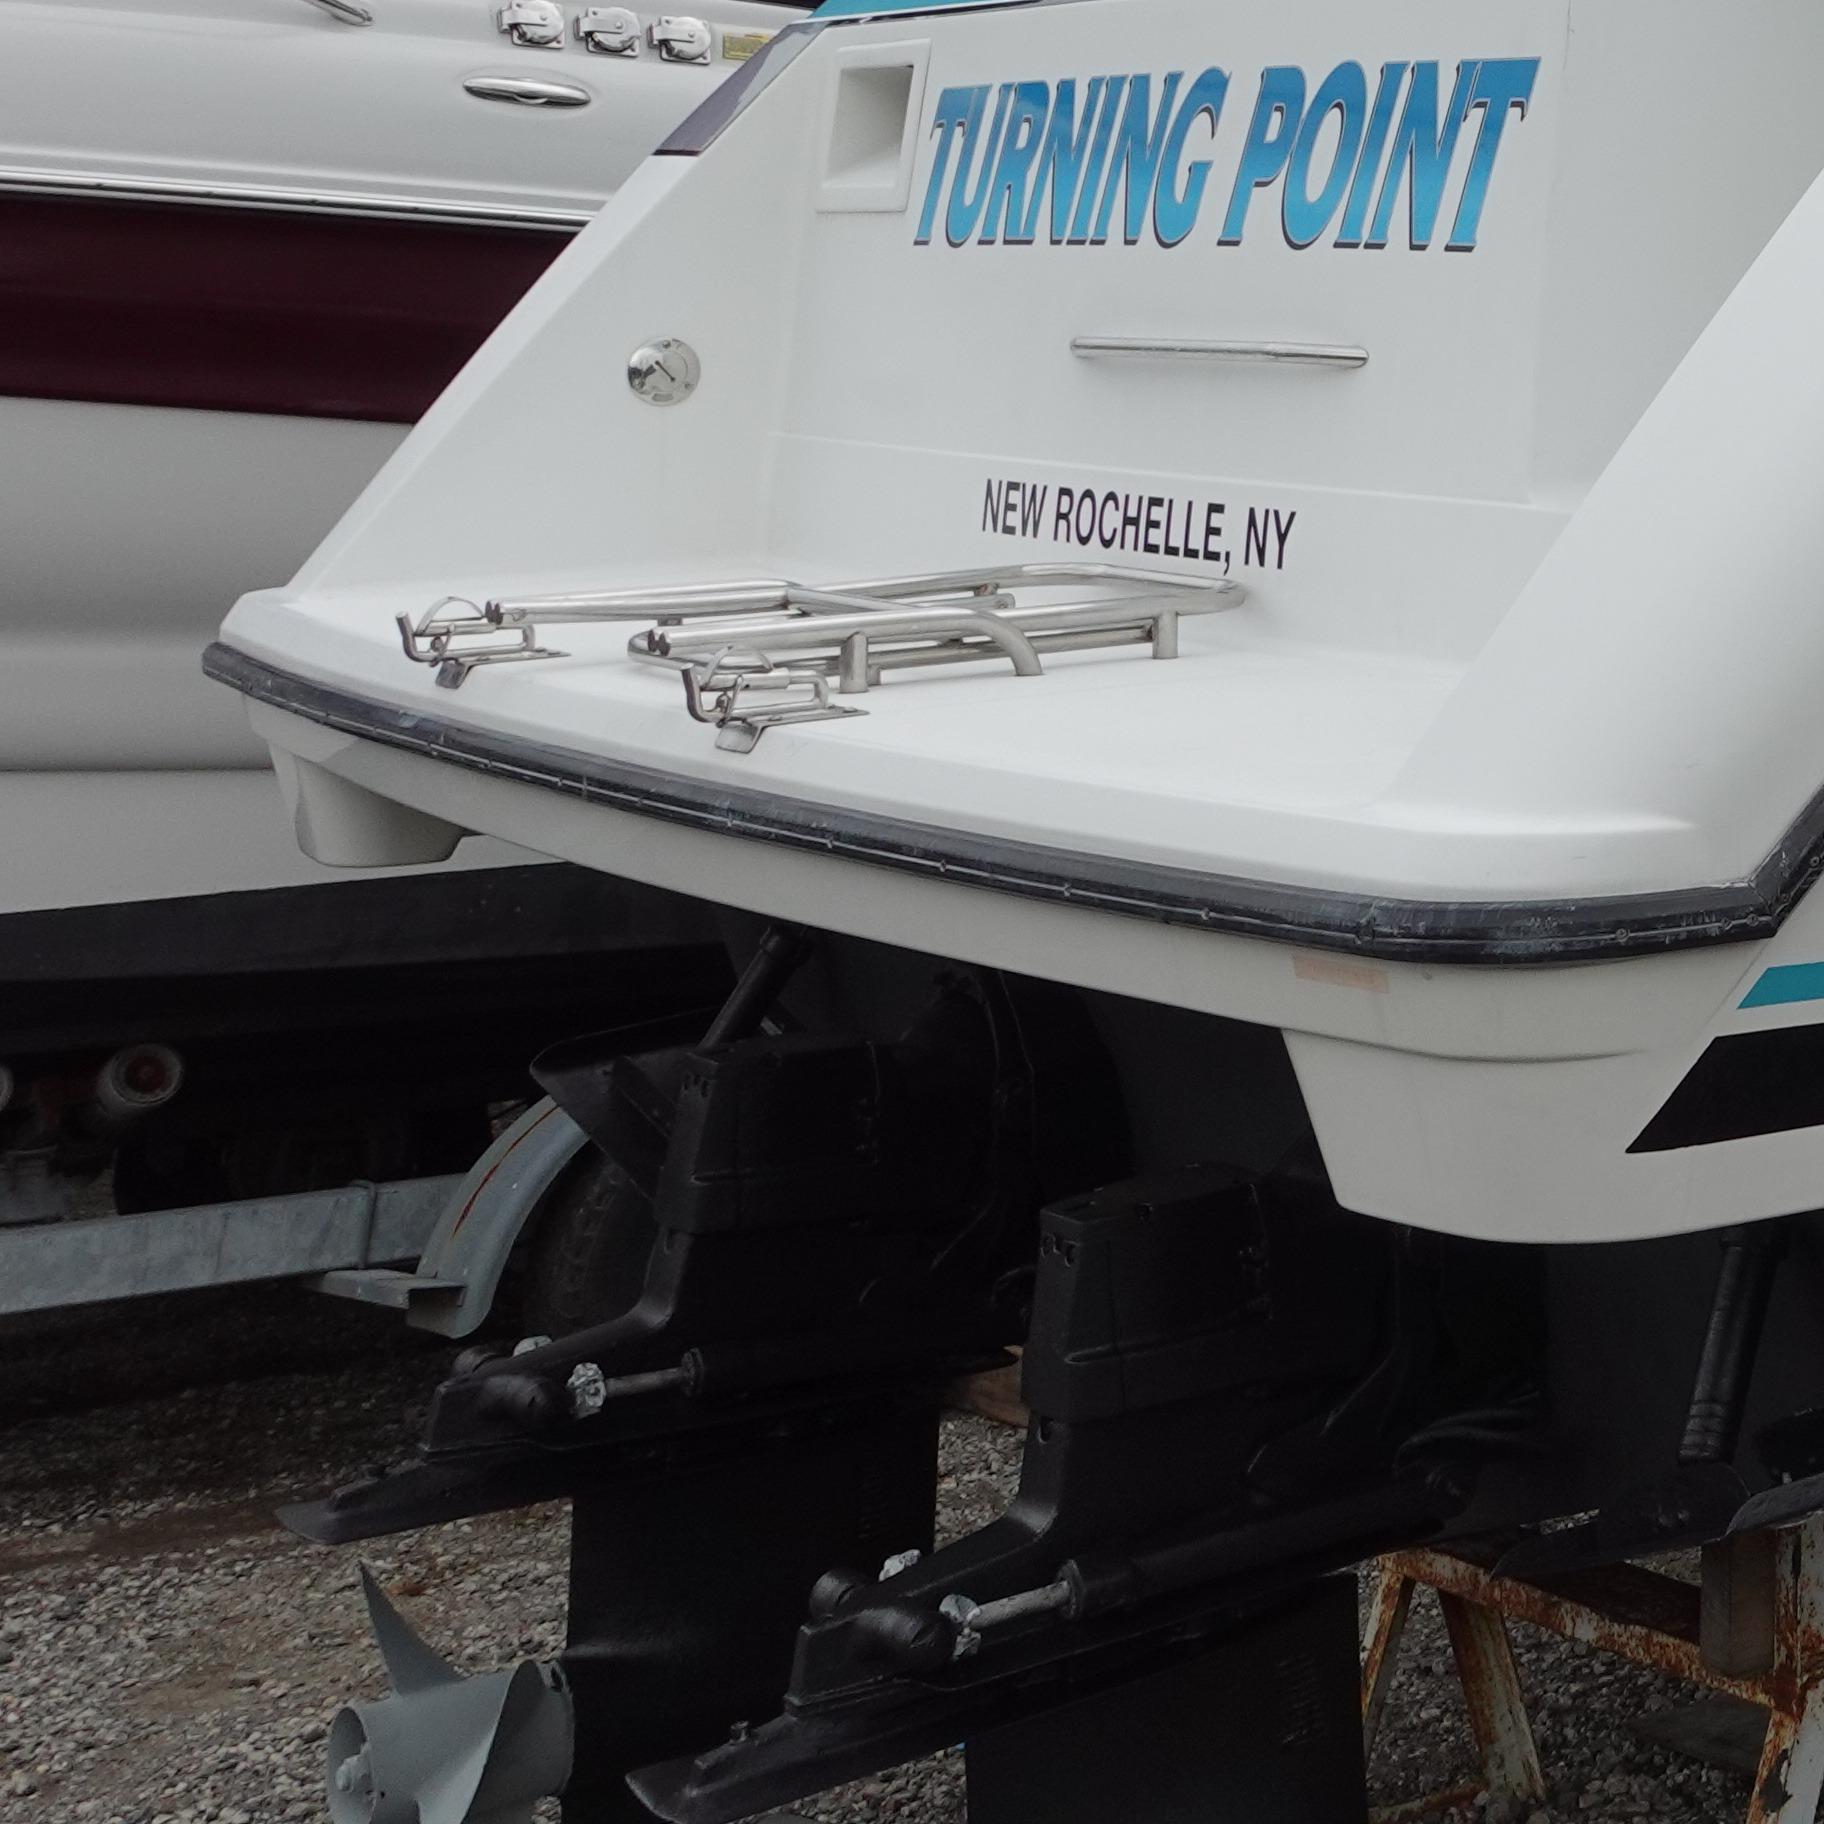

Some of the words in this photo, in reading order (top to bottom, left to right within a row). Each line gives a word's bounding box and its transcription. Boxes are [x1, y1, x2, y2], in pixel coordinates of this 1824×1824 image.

[913, 65, 1232, 248] TURNING
[1217, 56, 1541, 253] POINT
[982, 478, 1046, 538] NEW
[1053, 486, 1232, 575] ROCHELLE,
[1244, 507, 1297, 570] NY
